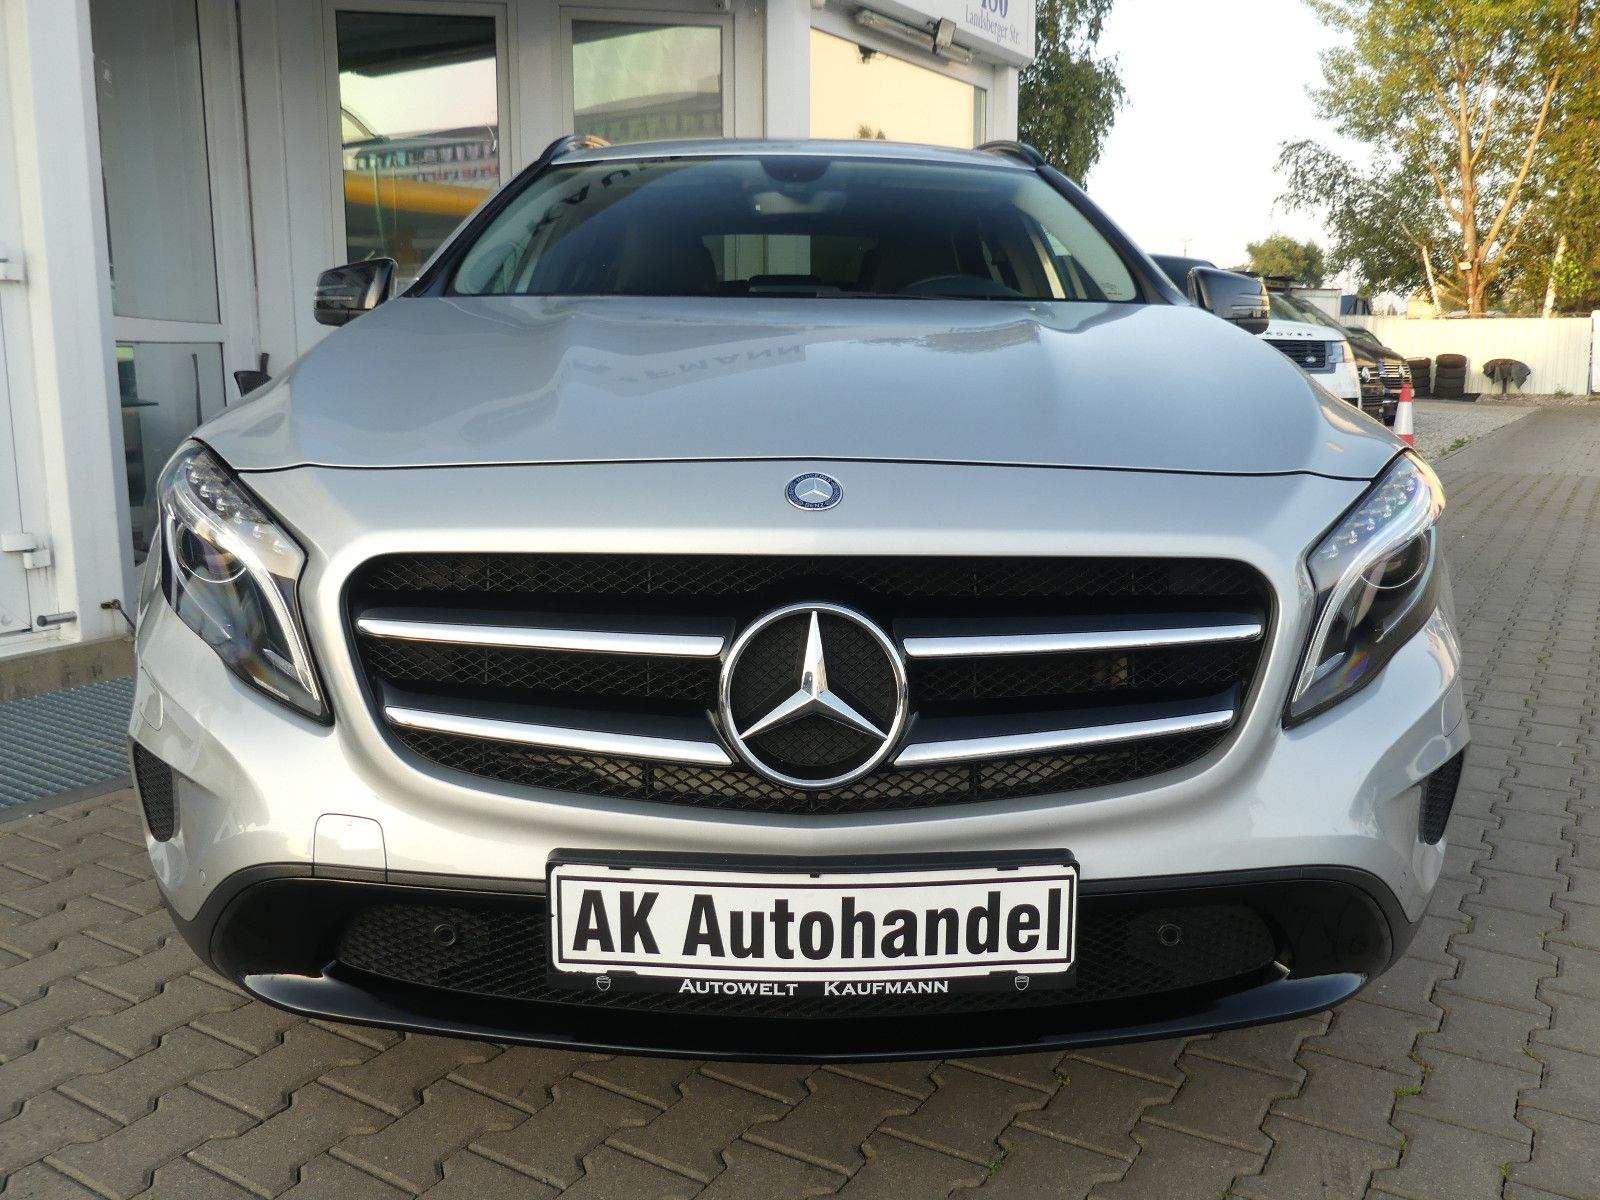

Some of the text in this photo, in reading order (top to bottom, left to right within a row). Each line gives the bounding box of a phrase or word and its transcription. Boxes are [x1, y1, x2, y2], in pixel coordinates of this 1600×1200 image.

[965, 4, 1009, 43] Landsberger
[572, 887, 1062, 960] AK Autohandel
[678, 978, 950, 997] AUTOWELT KAUFMANN
